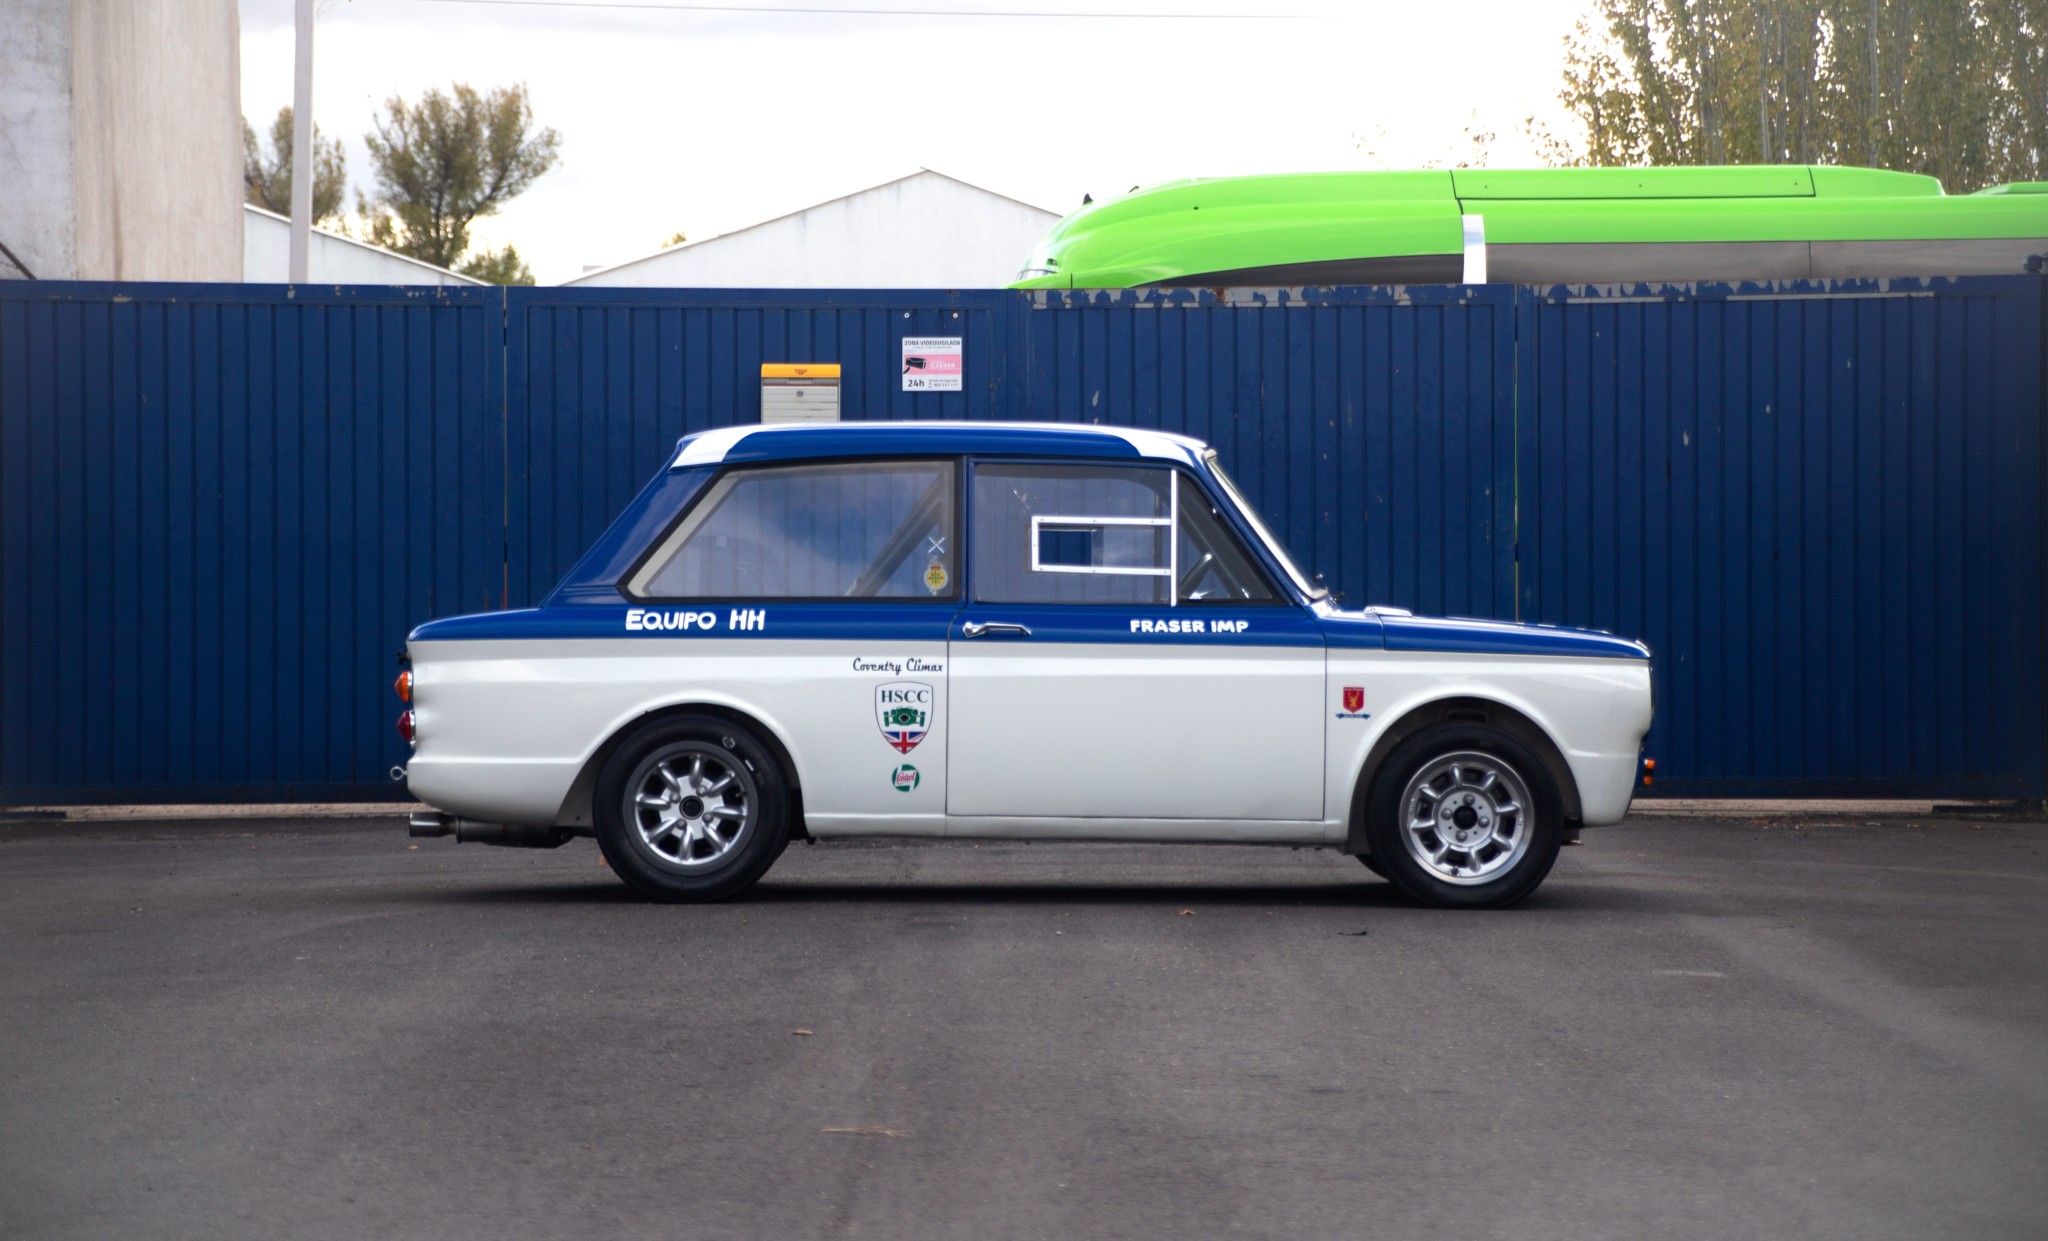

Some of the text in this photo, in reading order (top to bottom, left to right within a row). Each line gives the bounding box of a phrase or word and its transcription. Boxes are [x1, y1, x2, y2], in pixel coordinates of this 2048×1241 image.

[908, 379, 925, 387] 24h
[729, 609, 766, 631] HH
[1130, 620, 1249, 633] FRASER IMP
[853, 657, 943, 676] Coventry Climax
[881, 690, 929, 703] HSCC
